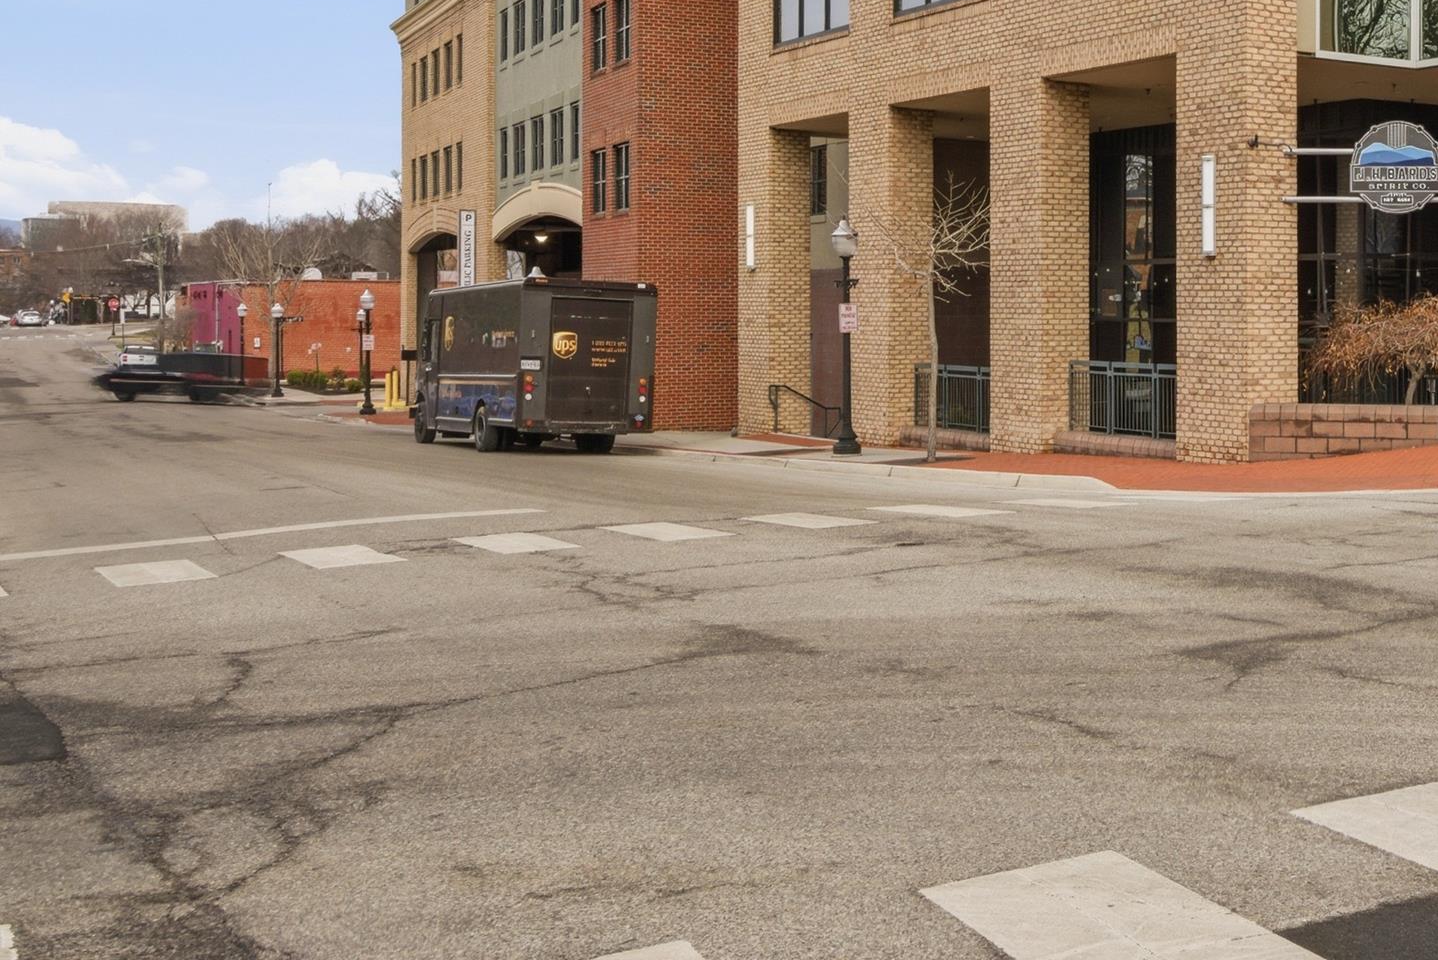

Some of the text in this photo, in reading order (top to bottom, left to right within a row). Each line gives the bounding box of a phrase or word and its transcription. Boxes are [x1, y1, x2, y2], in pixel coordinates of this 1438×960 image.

[1388, 167, 1438, 181] BARDS
[465, 214, 472, 222] P
[464, 230, 472, 268] PARKING
